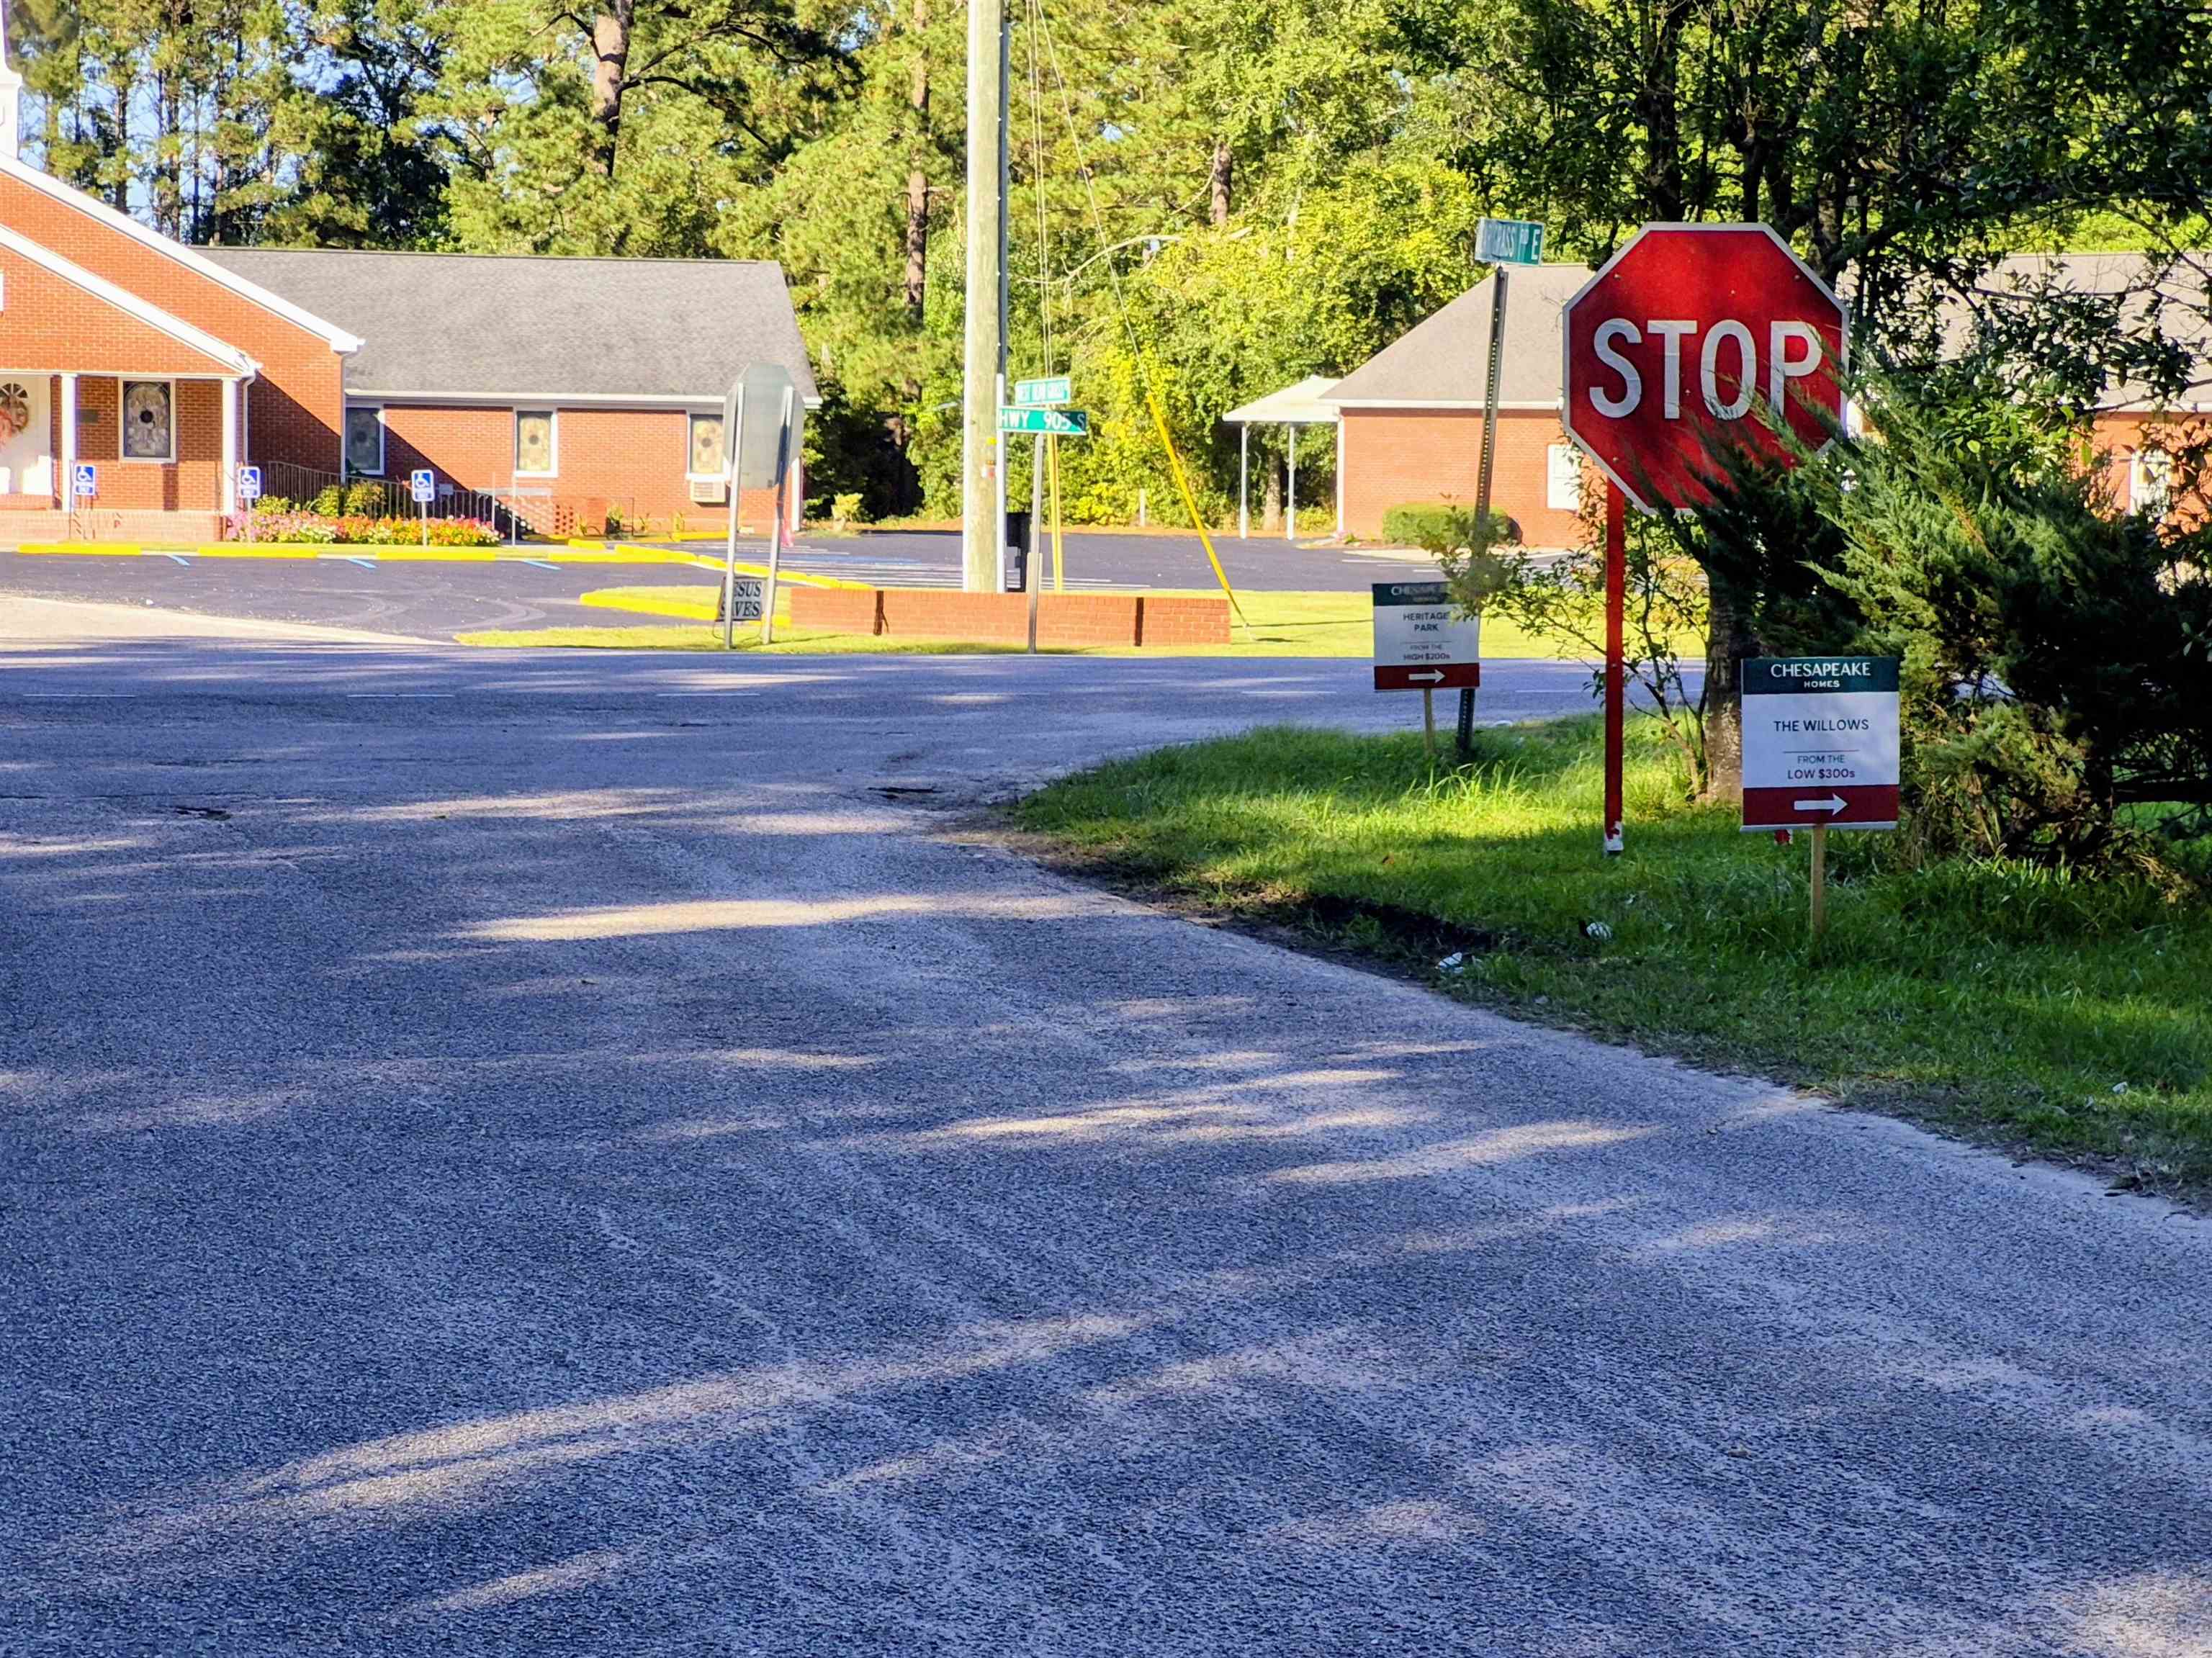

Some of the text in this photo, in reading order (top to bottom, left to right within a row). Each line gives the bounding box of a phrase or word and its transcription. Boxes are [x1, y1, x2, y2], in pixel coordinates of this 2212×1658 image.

[1588, 317, 1823, 420] STOP
[998, 410, 1085, 431] HWY 905 S
[1403, 611, 1449, 621] HERITAGE
[1413, 623, 1439, 632] PARK
[1770, 662, 1872, 677] CHESAPEAKE
[1804, 680, 1840, 689] HOMES
[1773, 718, 1869, 732] THE WILLOWS
[1797, 754, 1845, 764] FROM THE
[1787, 768, 1856, 780] LOW $300s
